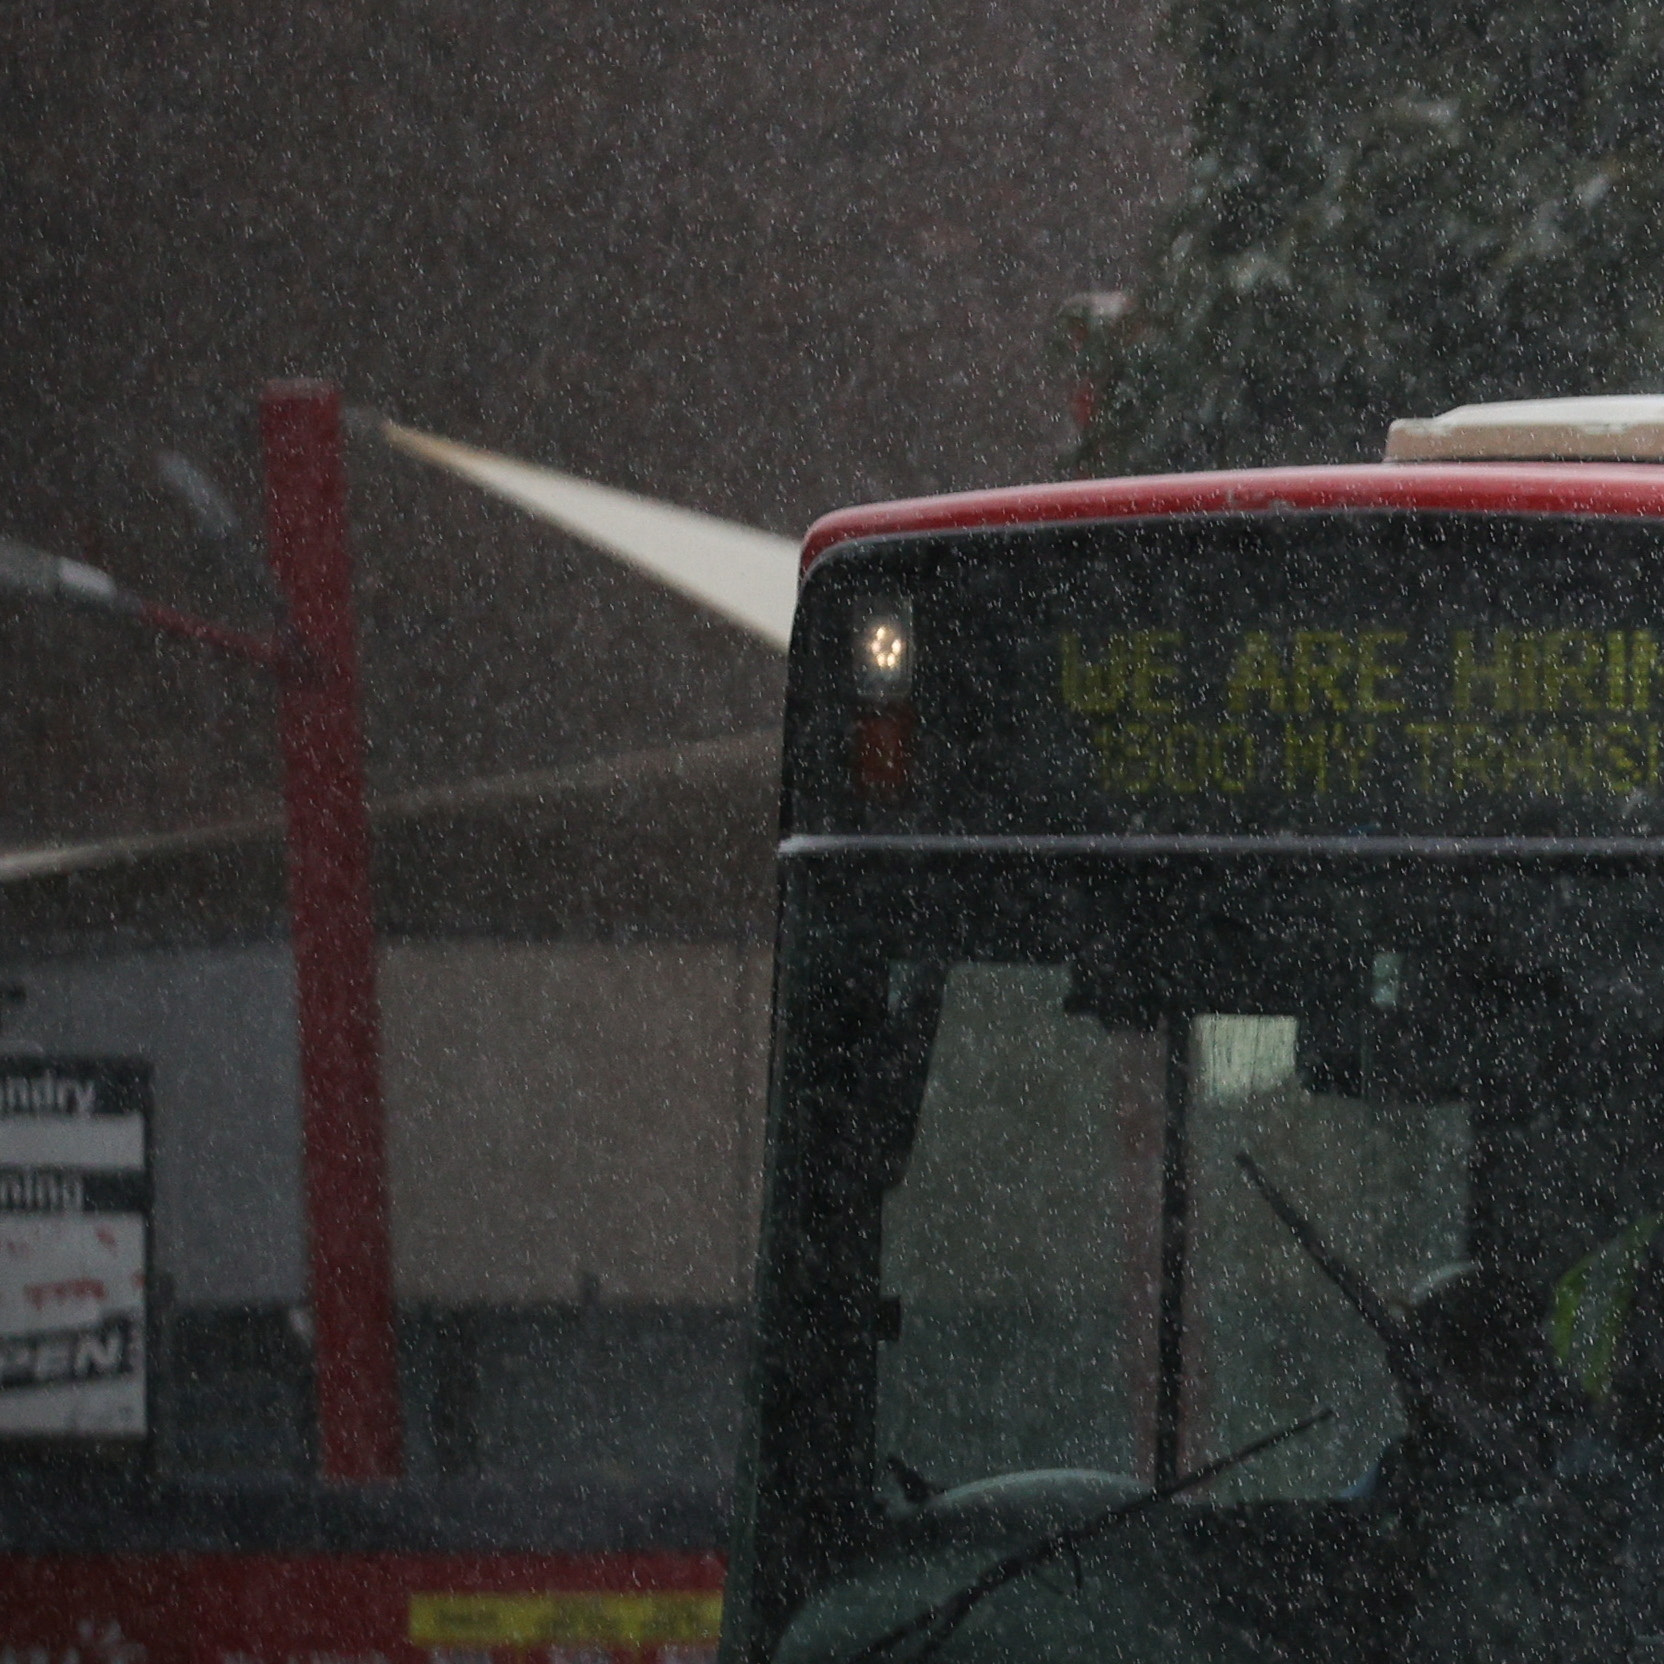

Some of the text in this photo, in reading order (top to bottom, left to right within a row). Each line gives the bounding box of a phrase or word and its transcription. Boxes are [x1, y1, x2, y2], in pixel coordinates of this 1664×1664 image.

[1061, 630, 1183, 713] WE
[1228, 630, 1408, 713] ARE
[0, 1325, 124, 1382] PEN
